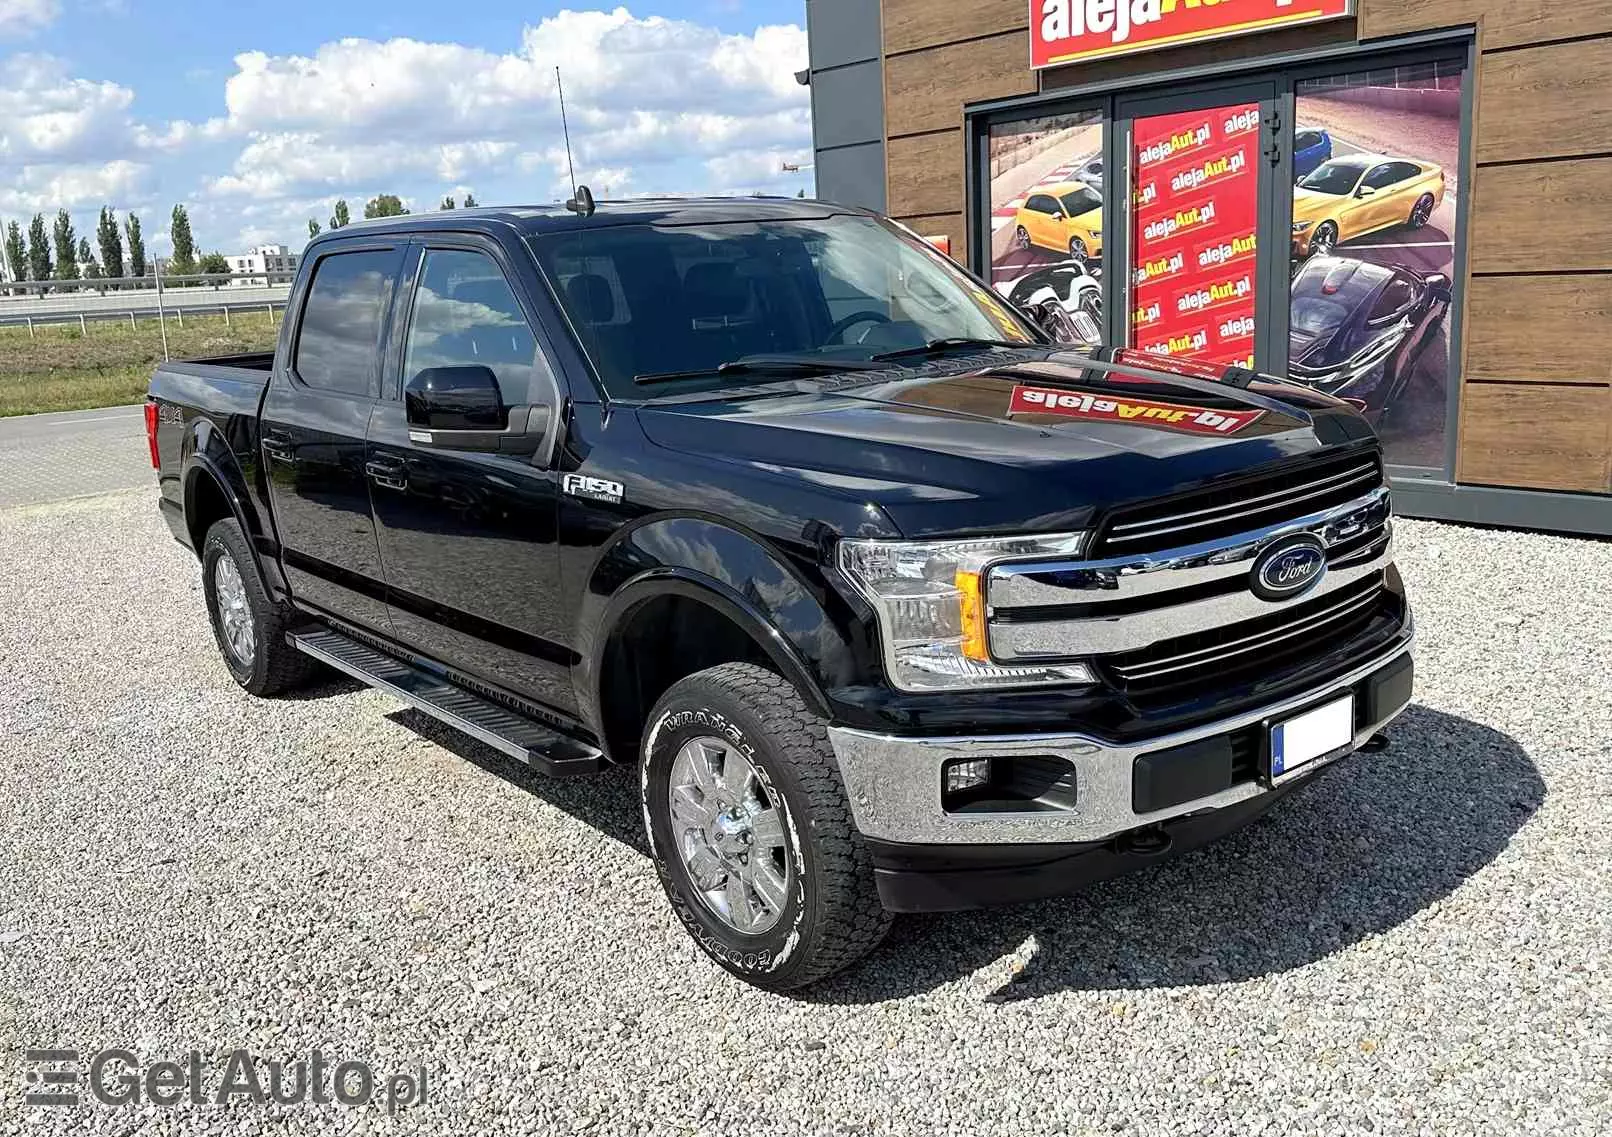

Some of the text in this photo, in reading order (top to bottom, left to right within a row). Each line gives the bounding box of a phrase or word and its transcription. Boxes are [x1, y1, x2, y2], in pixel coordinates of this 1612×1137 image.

[1139, 123, 1211, 164] alejaAut.pl
[1171, 150, 1245, 191] alejaAut.pl
[1144, 201, 1216, 240] alejaAut.pl
[1177, 276, 1252, 311] alejaAut.pl
[1219, 316, 1255, 337] aleja
[1279, 553, 1313, 582] Ford
